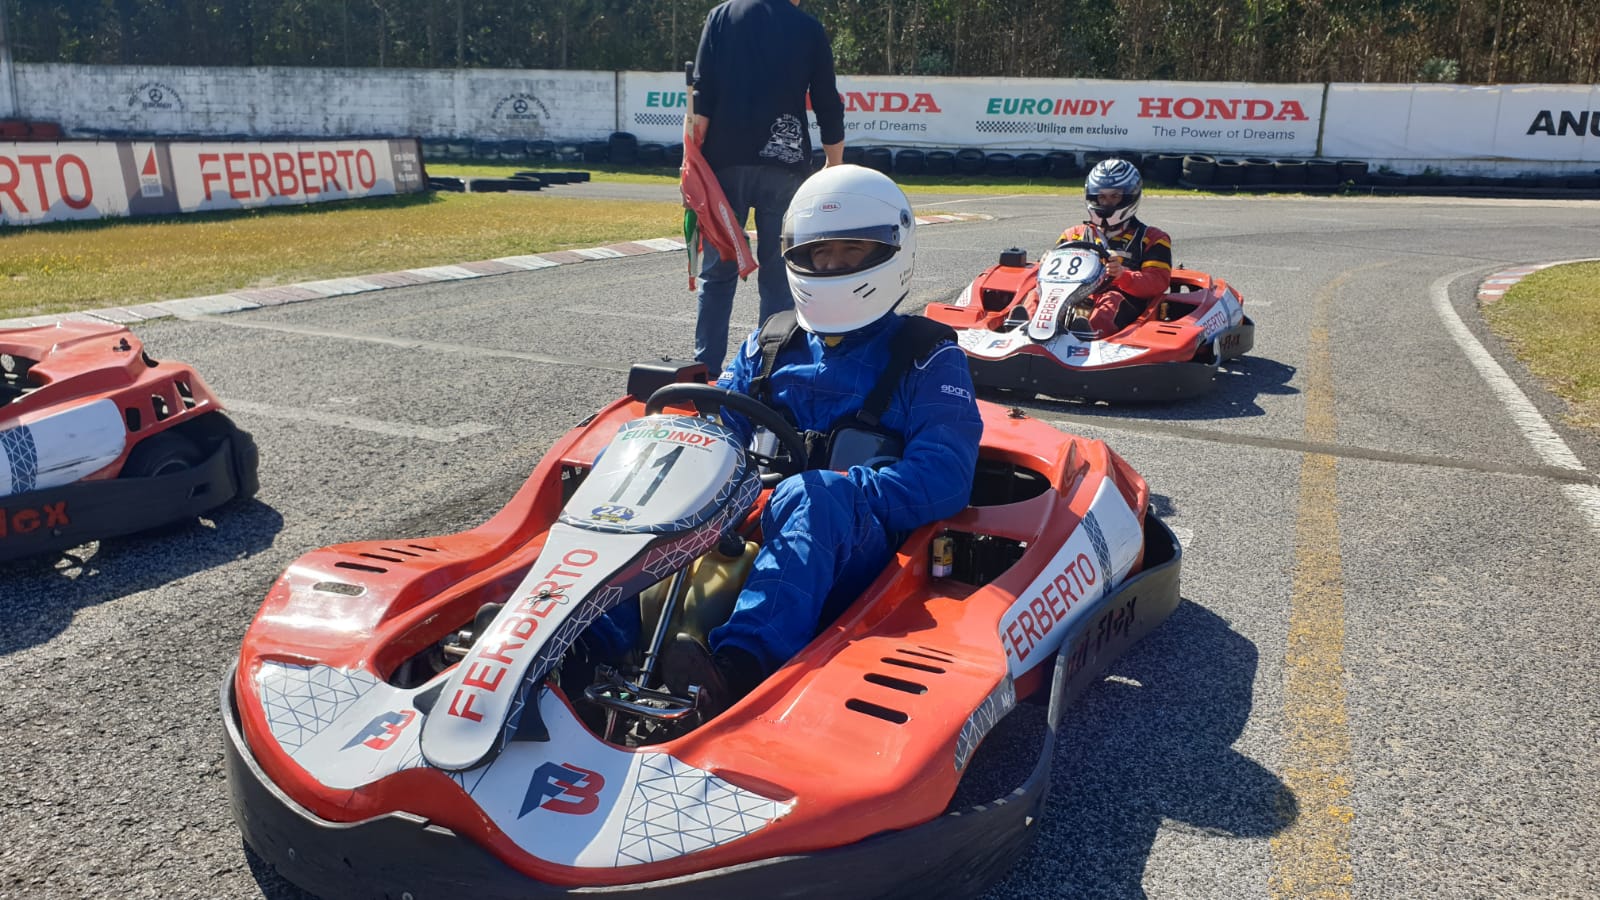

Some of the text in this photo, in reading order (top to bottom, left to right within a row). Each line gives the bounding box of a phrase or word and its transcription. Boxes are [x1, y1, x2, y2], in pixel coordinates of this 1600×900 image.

[838, 92, 942, 113] NDA
[986, 97, 1115, 117] EUROINDY
[1137, 97, 1310, 121] HONDA
[863, 120, 876, 131] of
[879, 120, 928, 132] Dreams
[1069, 126, 1084, 134] em
[1086, 124, 1129, 136] exclusivo
[1152, 125, 1296, 140] The Power of Dreams
[197, 148, 377, 201] FERBERTO
[1047, 256, 1083, 276] 28
[1036, 288, 1065, 330] FERBERTO
[622, 428, 717, 447] EUROINDY
[608, 442, 686, 507] 11
[447, 547, 599, 723] FERBERTO
